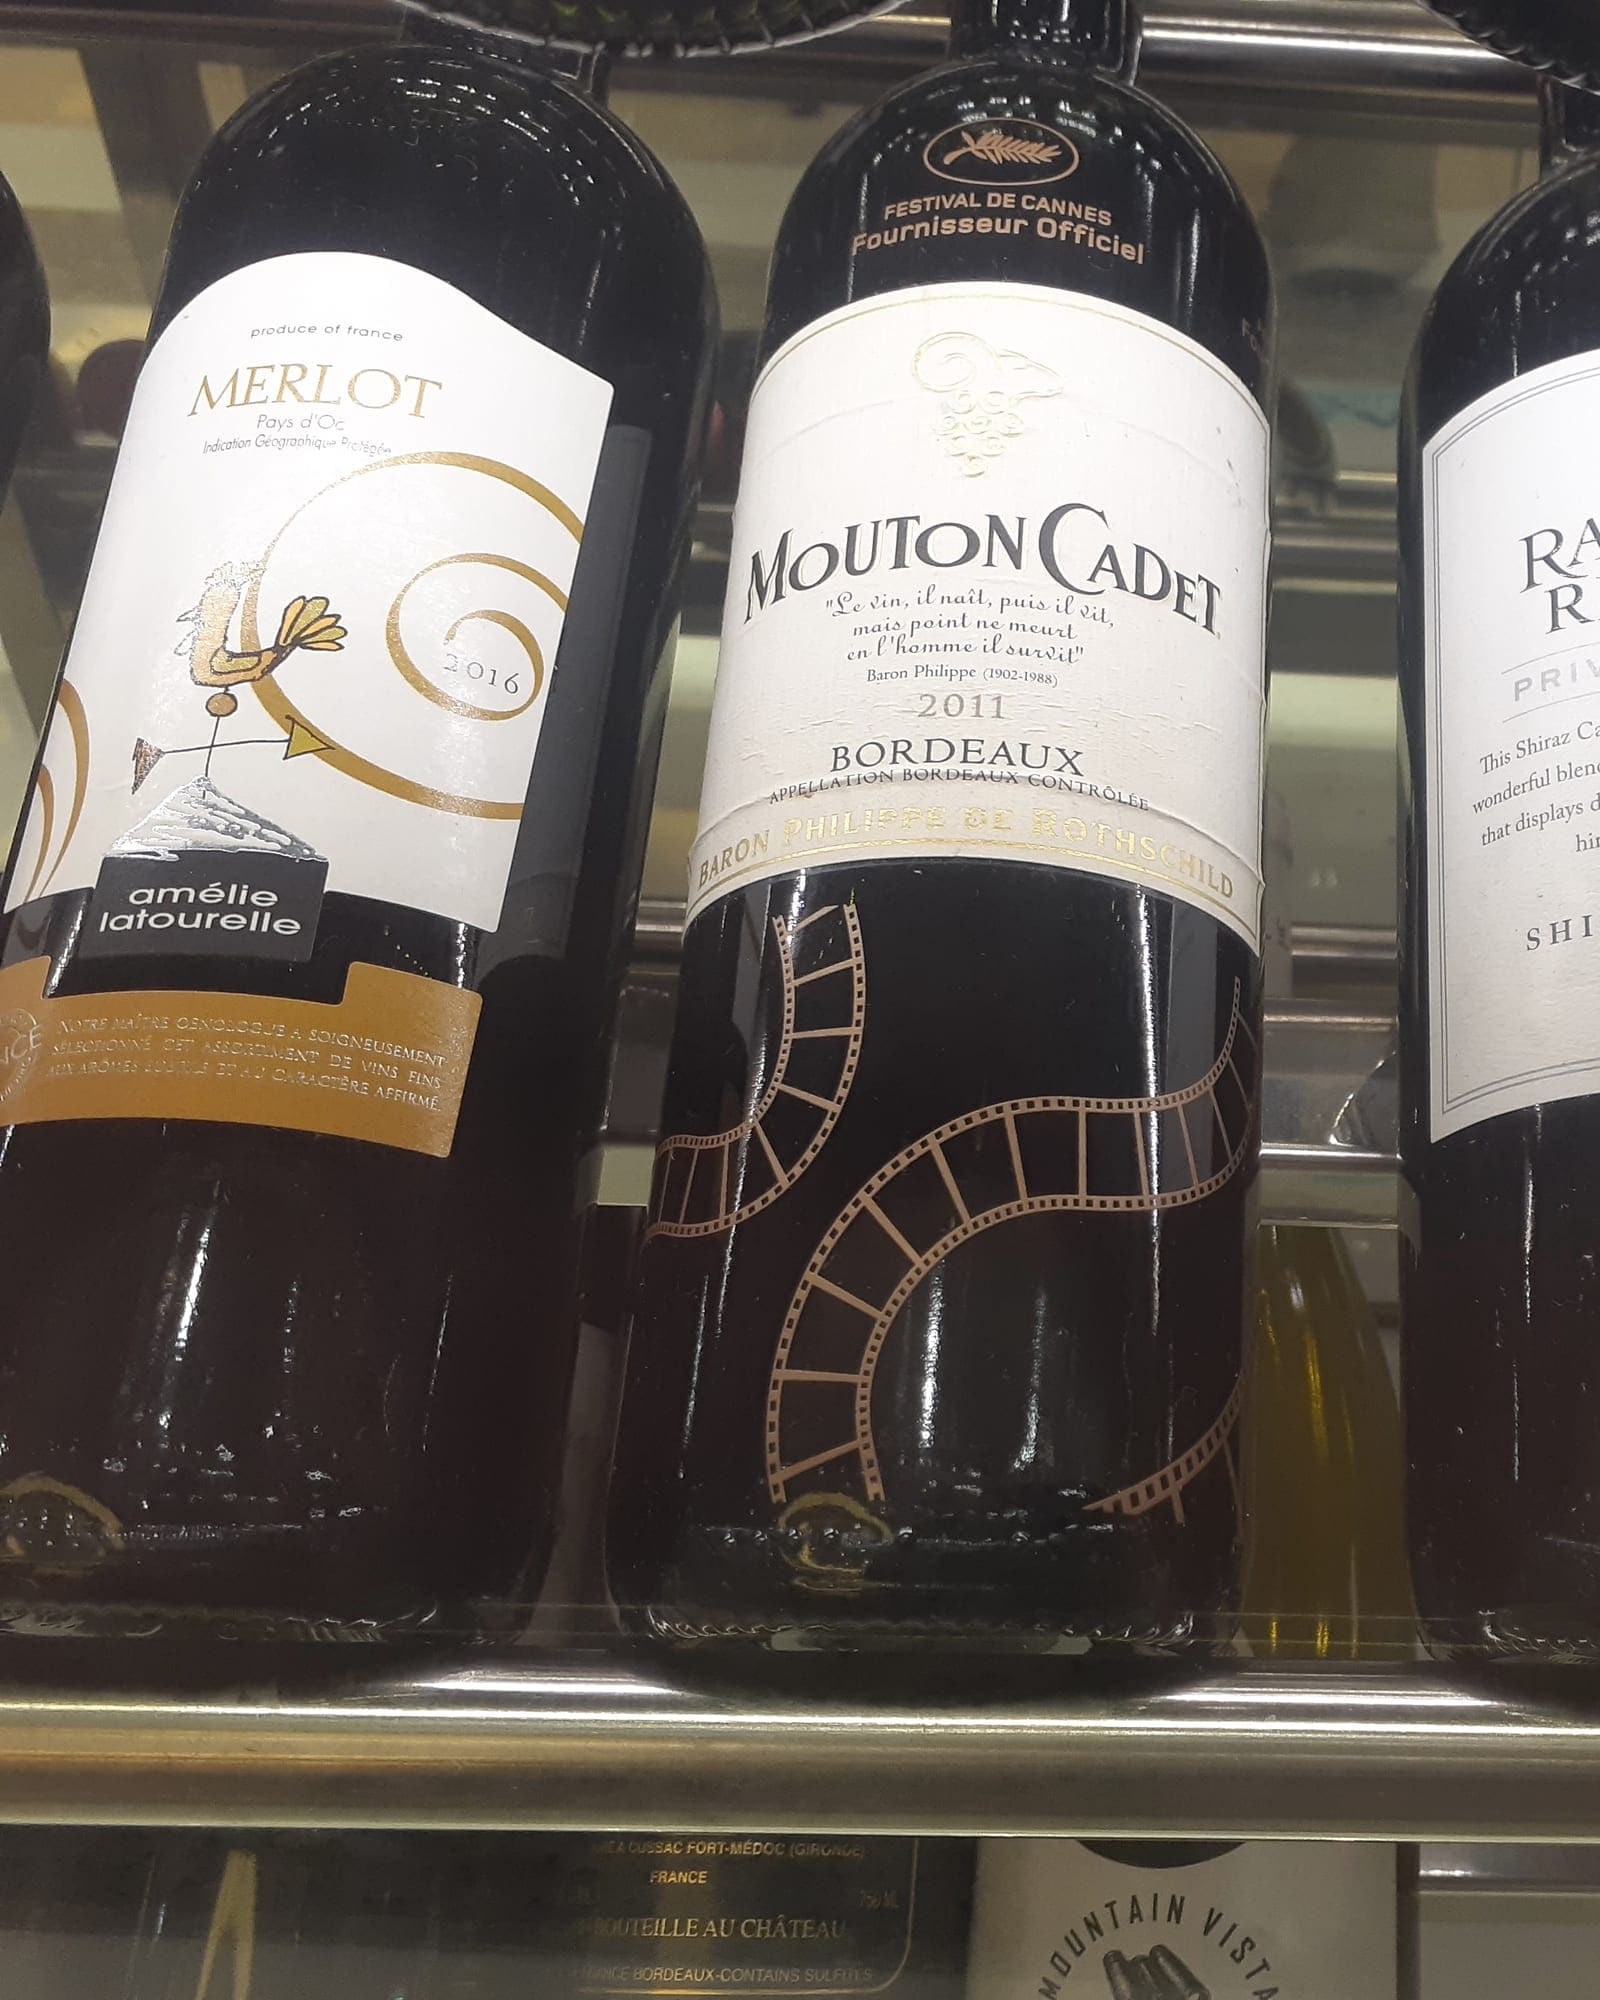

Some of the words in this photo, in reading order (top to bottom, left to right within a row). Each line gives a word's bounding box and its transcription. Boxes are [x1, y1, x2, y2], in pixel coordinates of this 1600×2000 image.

[884, 192, 982, 220] FESTIVAL
[987, 192, 1016, 209] DE
[1021, 194, 1112, 226] CANNES
[852, 215, 1029, 256] Fournisseur
[1036, 216, 1145, 264] Officiel
[251, 324, 318, 339] produce
[324, 324, 341, 335] of
[347, 325, 404, 342] france
[187, 362, 443, 419] MERLOT
[256, 413, 294, 432] Pays
[203, 436, 251, 455] Indication
[743, 513, 1025, 625] MOUTON
[1038, 502, 1222, 637] CADET
[917, 583, 936, 605] il
[999, 593, 1048, 614] puis
[1055, 594, 1075, 617] il
[853, 616, 902, 637] mais
[909, 612, 972, 638] point
[976, 618, 1001, 630] ne
[1009, 621, 1079, 641] meurt
[847, 648, 869, 662] en
[876, 633, 978, 657] l'homme
[982, 632, 1002, 655] il
[443, 652, 520, 695] 2016
[867, 668, 909, 682] Baron
[914, 663, 977, 681] Philippe
[983, 666, 1059, 688] (1902-1988)
[917, 693, 1007, 720] 2011
[830, 737, 1085, 777] BORDEAUX
[1480, 750, 1512, 775] This
[1516, 732, 1571, 759] Shiraz
[770, 769, 894, 805] APPELLATION
[902, 767, 1020, 785] BORDEAUX
[1028, 773, 1150, 812] CONTRÔLÉE
[1472, 768, 1552, 815] wonderful
[1481, 822, 1512, 847] that
[1515, 801, 1584, 831] displays
[698, 829, 771, 889] BARON
[783, 806, 947, 847] PHILIPPE
[964, 806, 1013, 831] DE
[1033, 807, 1235, 899] ROTHSCHILD
[128, 881, 279, 907] amélie
[99, 908, 302, 935] latourelle
[1526, 914, 1594, 951] SHI
[308, 1028, 446, 1068] SOIGNEUSEMENT
[330, 1053, 353, 1070] DE
[361, 1059, 399, 1080] VINS
[407, 1070, 442, 1090] FINS
[686, 1839, 786, 1856] FORT-MÉDOC
[651, 1870, 708, 1884] FRANCE
[702, 1918, 736, 1938] AU
[740, 1913, 847, 1939] CHÂTEAU
[1038, 1892, 1186, 2000] MOUNTAIN
[1203, 1906, 1280, 2000] VISTA
